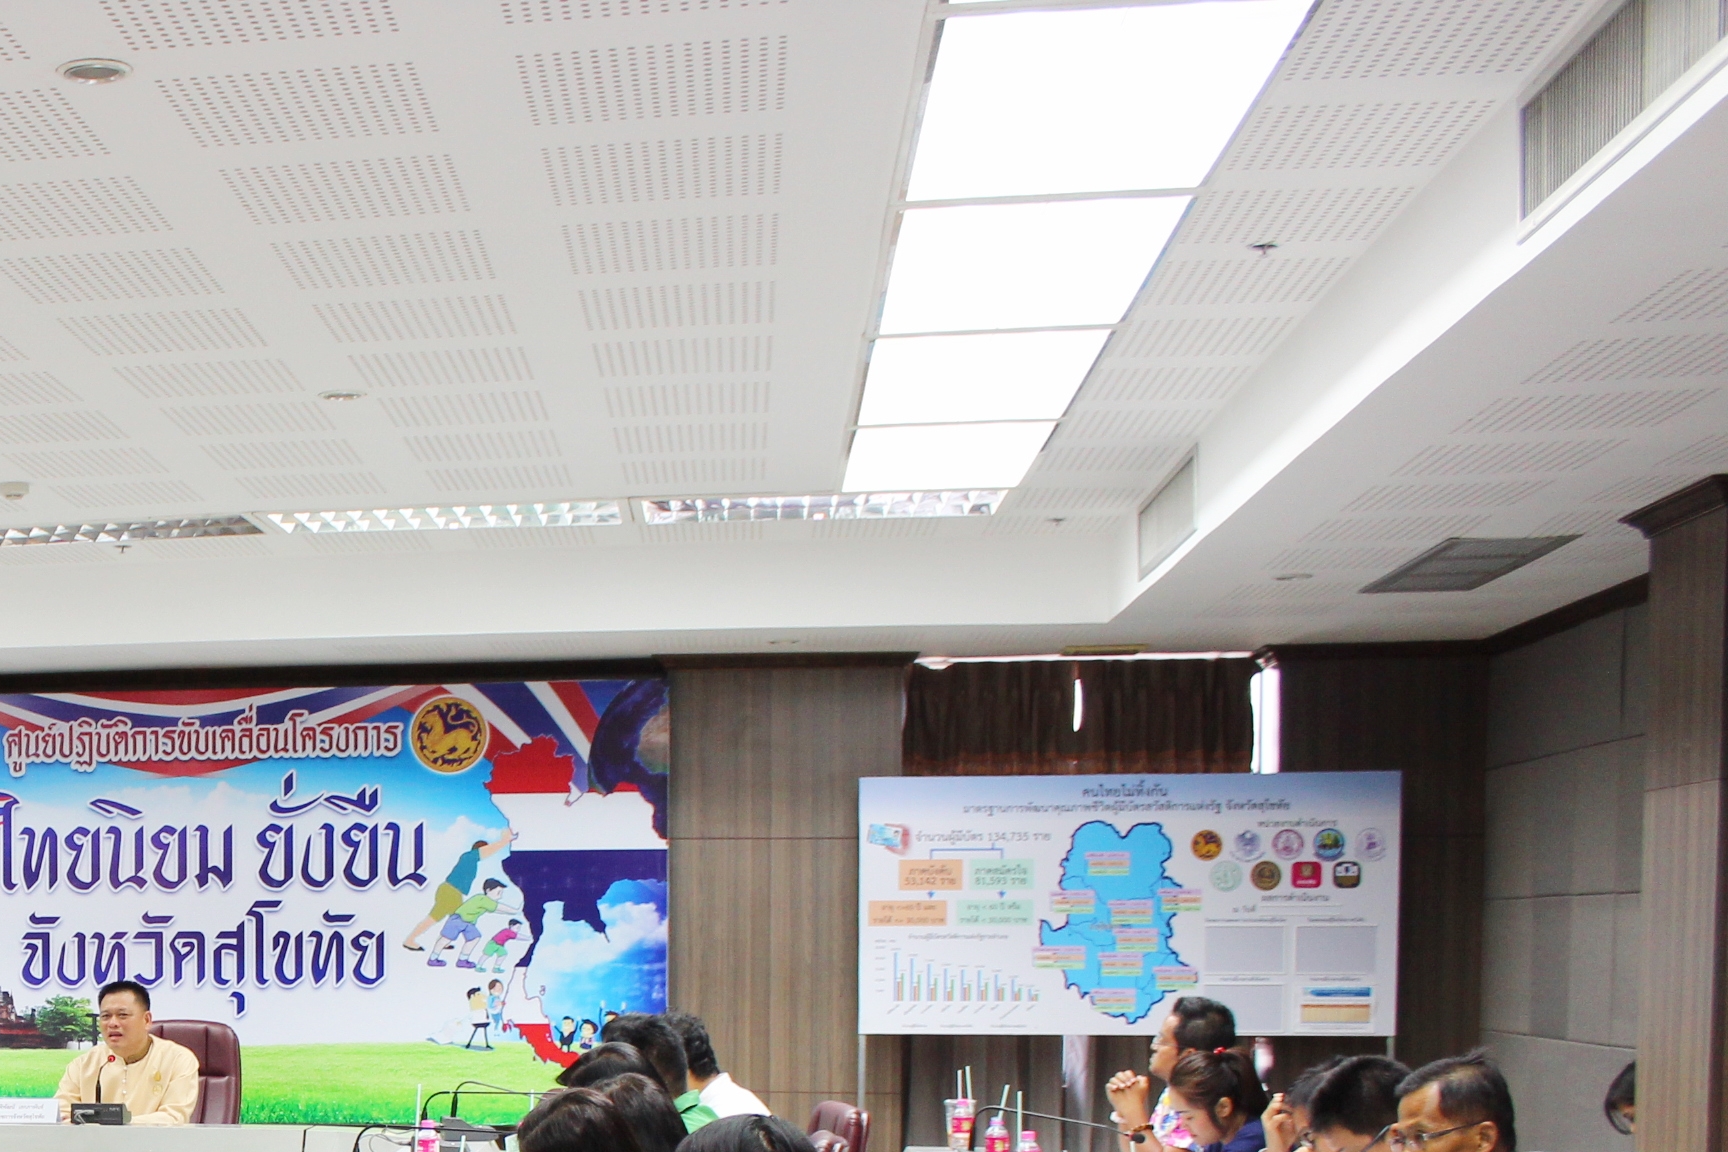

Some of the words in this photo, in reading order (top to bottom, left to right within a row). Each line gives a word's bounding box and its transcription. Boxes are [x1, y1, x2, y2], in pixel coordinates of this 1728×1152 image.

[6, 704, 400, 774] ศูนย์ปฏิบัติการขับเคลื่อนโครงการ
[1, 797, 234, 891] ไทยนิยม
[256, 770, 429, 890] ยั่งยืน
[21, 899, 387, 1017] จังหวัดสุโขทัย
